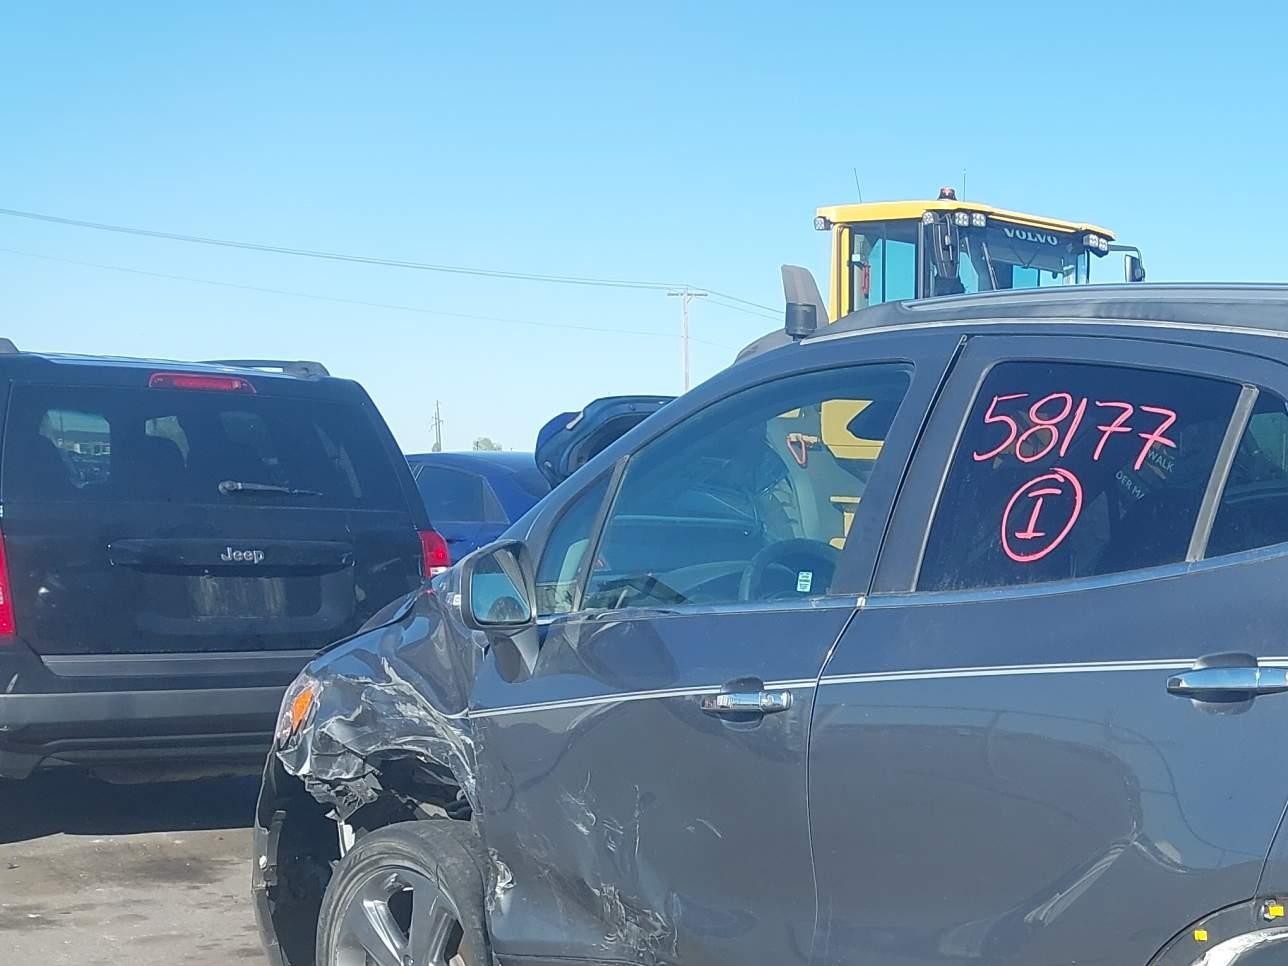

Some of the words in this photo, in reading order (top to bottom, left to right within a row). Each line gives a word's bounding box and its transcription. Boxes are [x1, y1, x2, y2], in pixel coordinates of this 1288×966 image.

[1004, 228, 1058, 246] VOLVO
[973, 391, 1177, 471] 58177
[1148, 451, 1175, 472] WALK
[220, 546, 265, 564] Jeep
